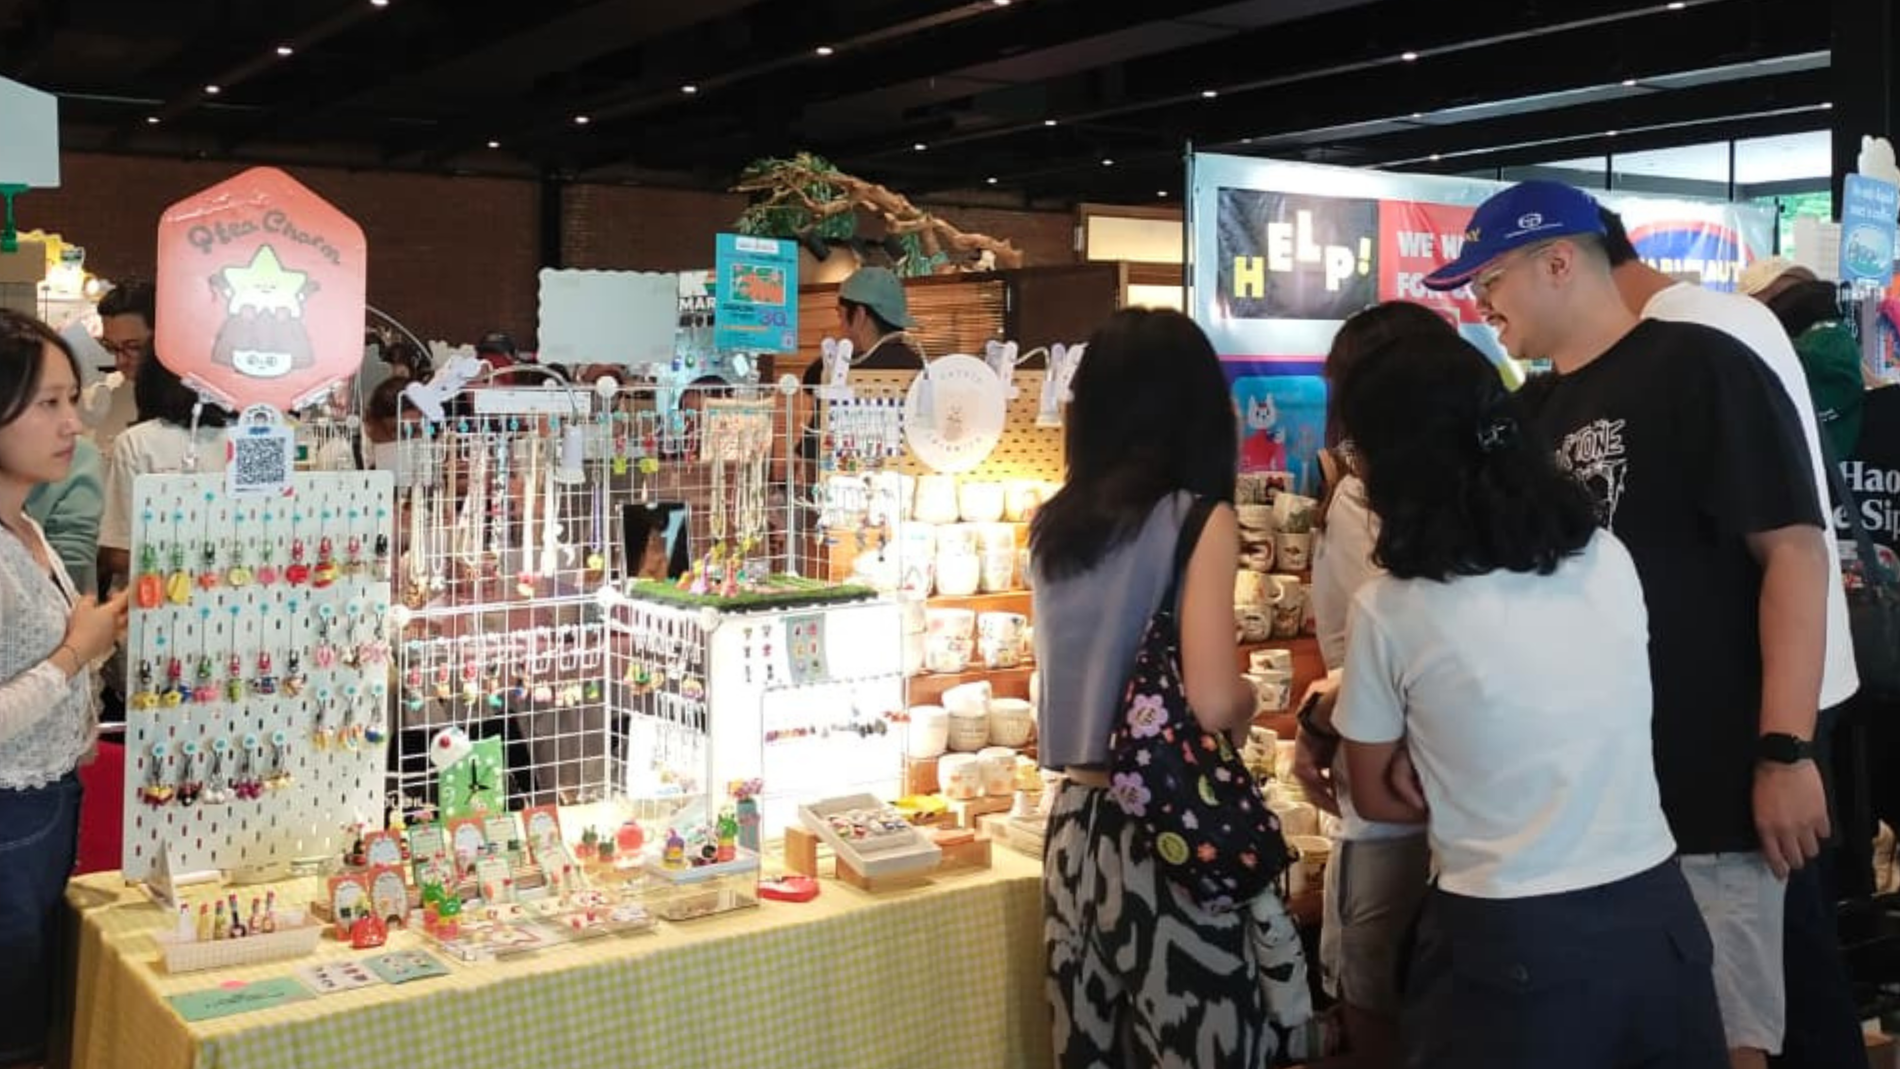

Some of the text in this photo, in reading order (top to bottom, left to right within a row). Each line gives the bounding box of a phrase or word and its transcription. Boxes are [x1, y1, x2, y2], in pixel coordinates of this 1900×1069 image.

[1233, 210, 1372, 298] HELP!
[1397, 230, 1435, 258] WE
[679, 297, 717, 312] MAR
